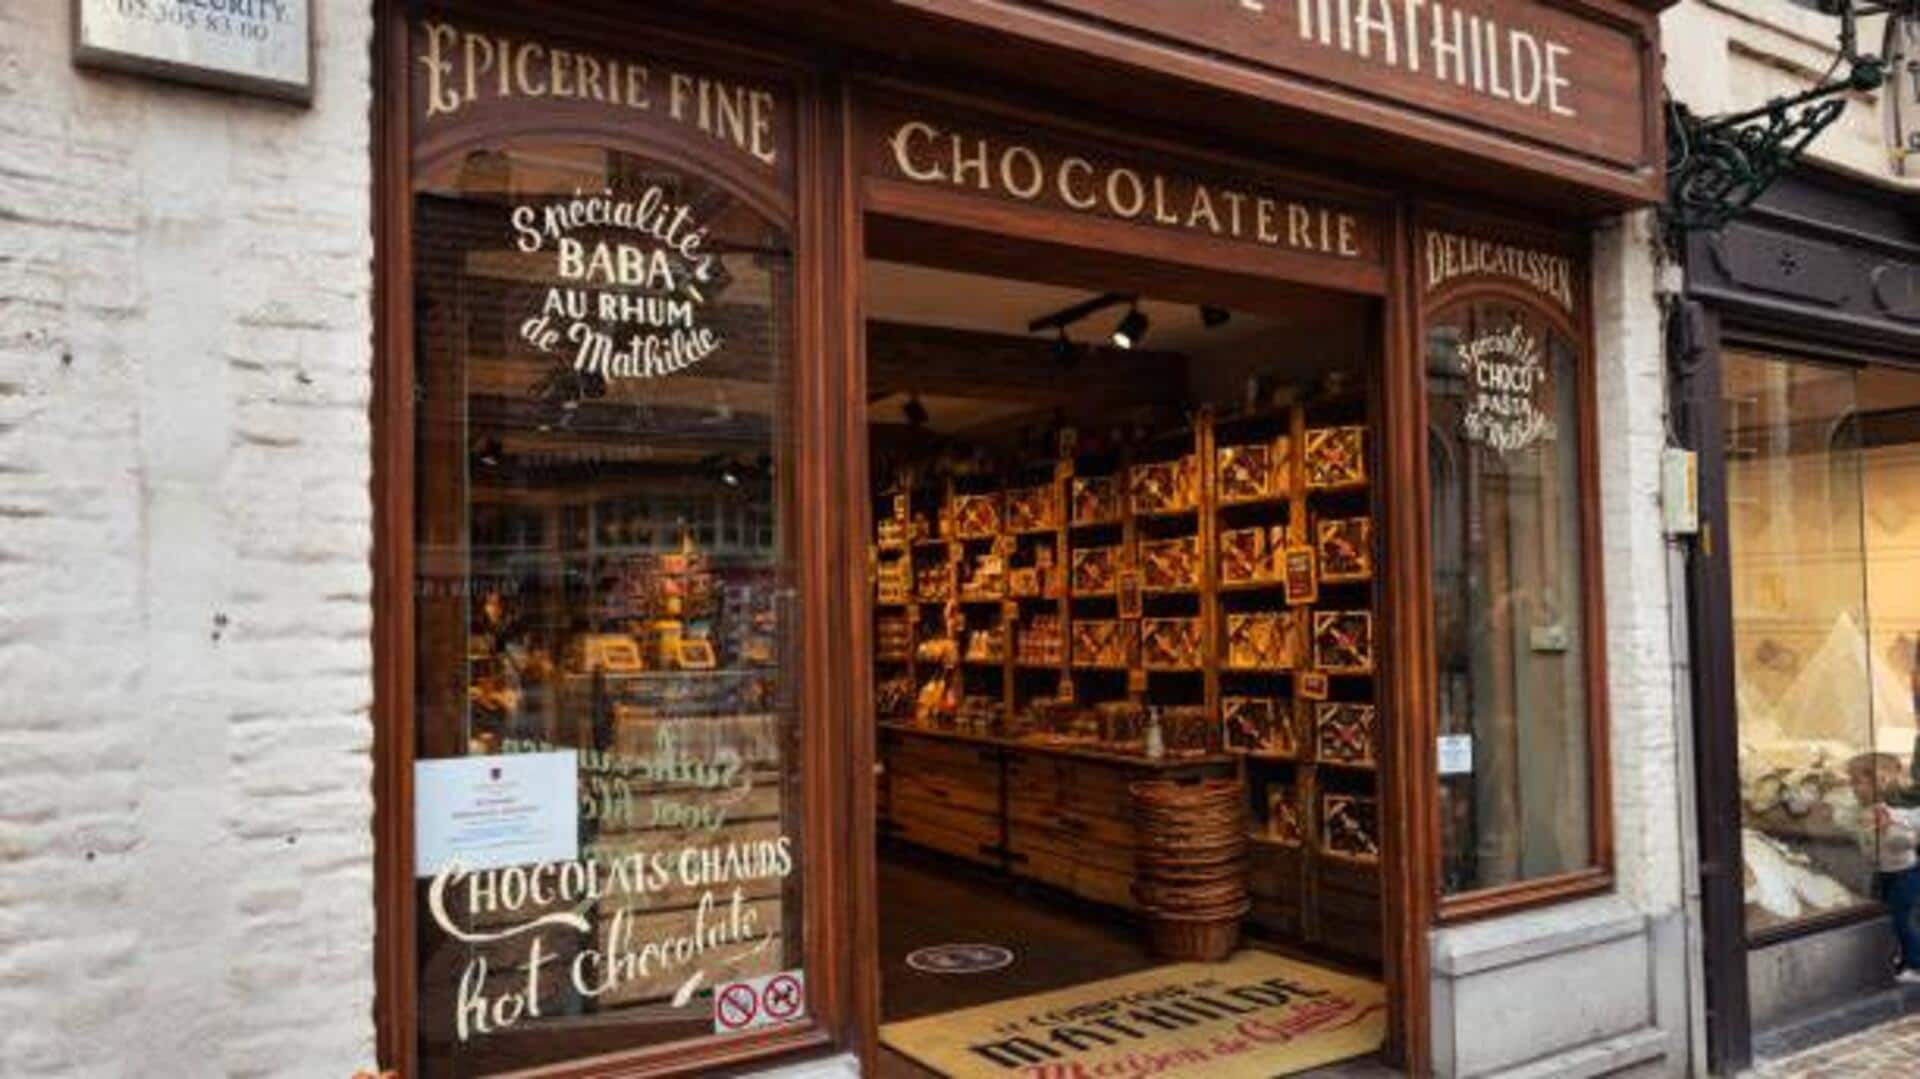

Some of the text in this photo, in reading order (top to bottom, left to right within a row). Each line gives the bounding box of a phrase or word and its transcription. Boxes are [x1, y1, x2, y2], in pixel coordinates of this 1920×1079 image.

[419, 22, 777, 166] EPICERIE FINE
[888, 121, 1361, 257] CHOCOLATERIE
[558, 237, 676, 291] BABA
[543, 288, 693, 328] AU RHUM
[520, 315, 724, 384] de Mathilde
[679, 836, 793, 888] CHAUDS
[456, 937, 560, 1041] hot
[969, 977, 1331, 1069] MATHILDE
